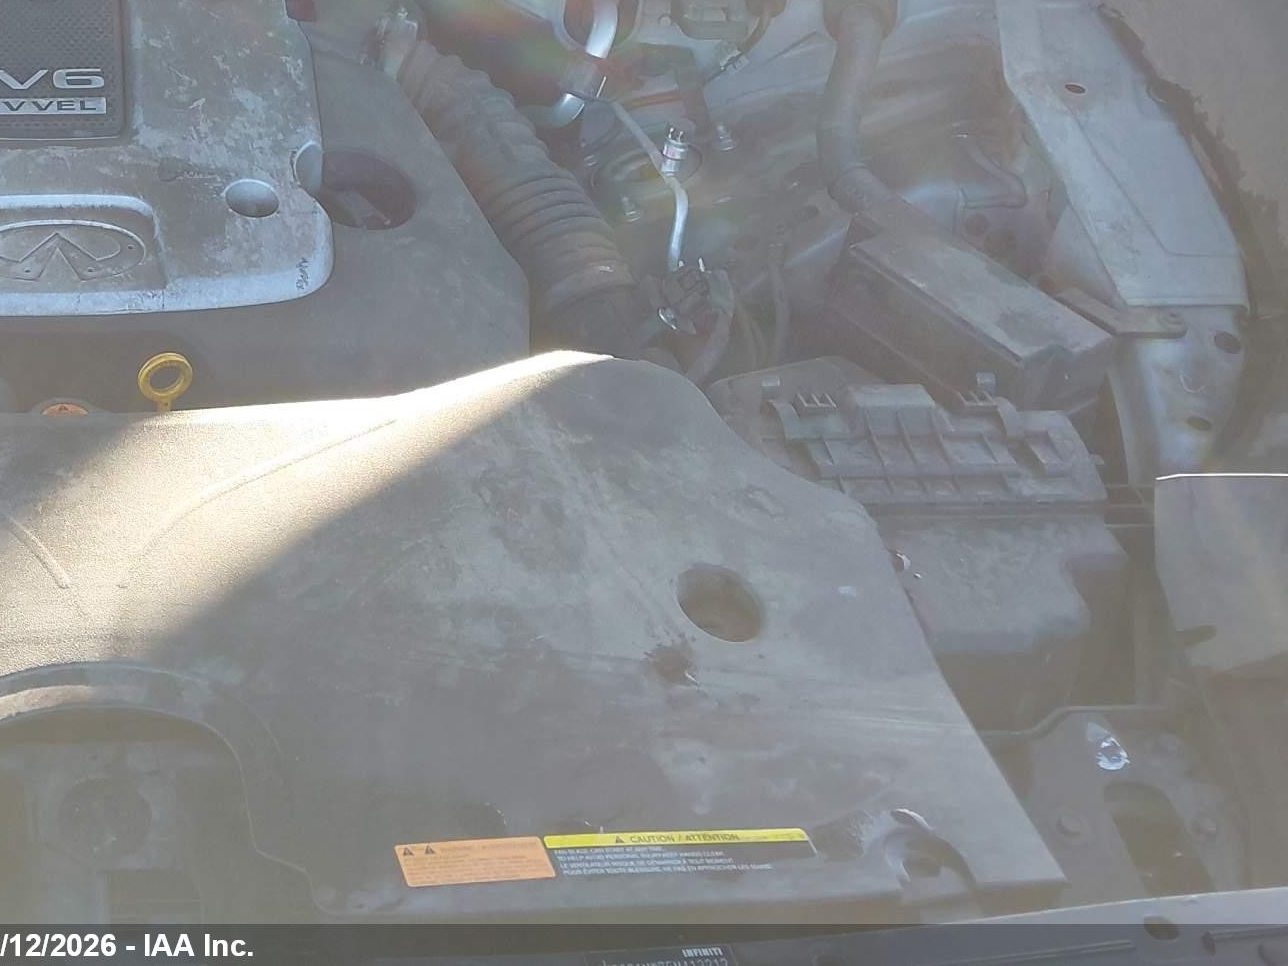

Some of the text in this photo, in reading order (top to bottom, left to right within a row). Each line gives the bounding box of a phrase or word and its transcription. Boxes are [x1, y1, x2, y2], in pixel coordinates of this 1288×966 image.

[1, 100, 98, 112] VVEL
[630, 835, 675, 844] CAUTION
[686, 833, 740, 843] ATTENTION
[681, 947, 724, 958] INFINITI
